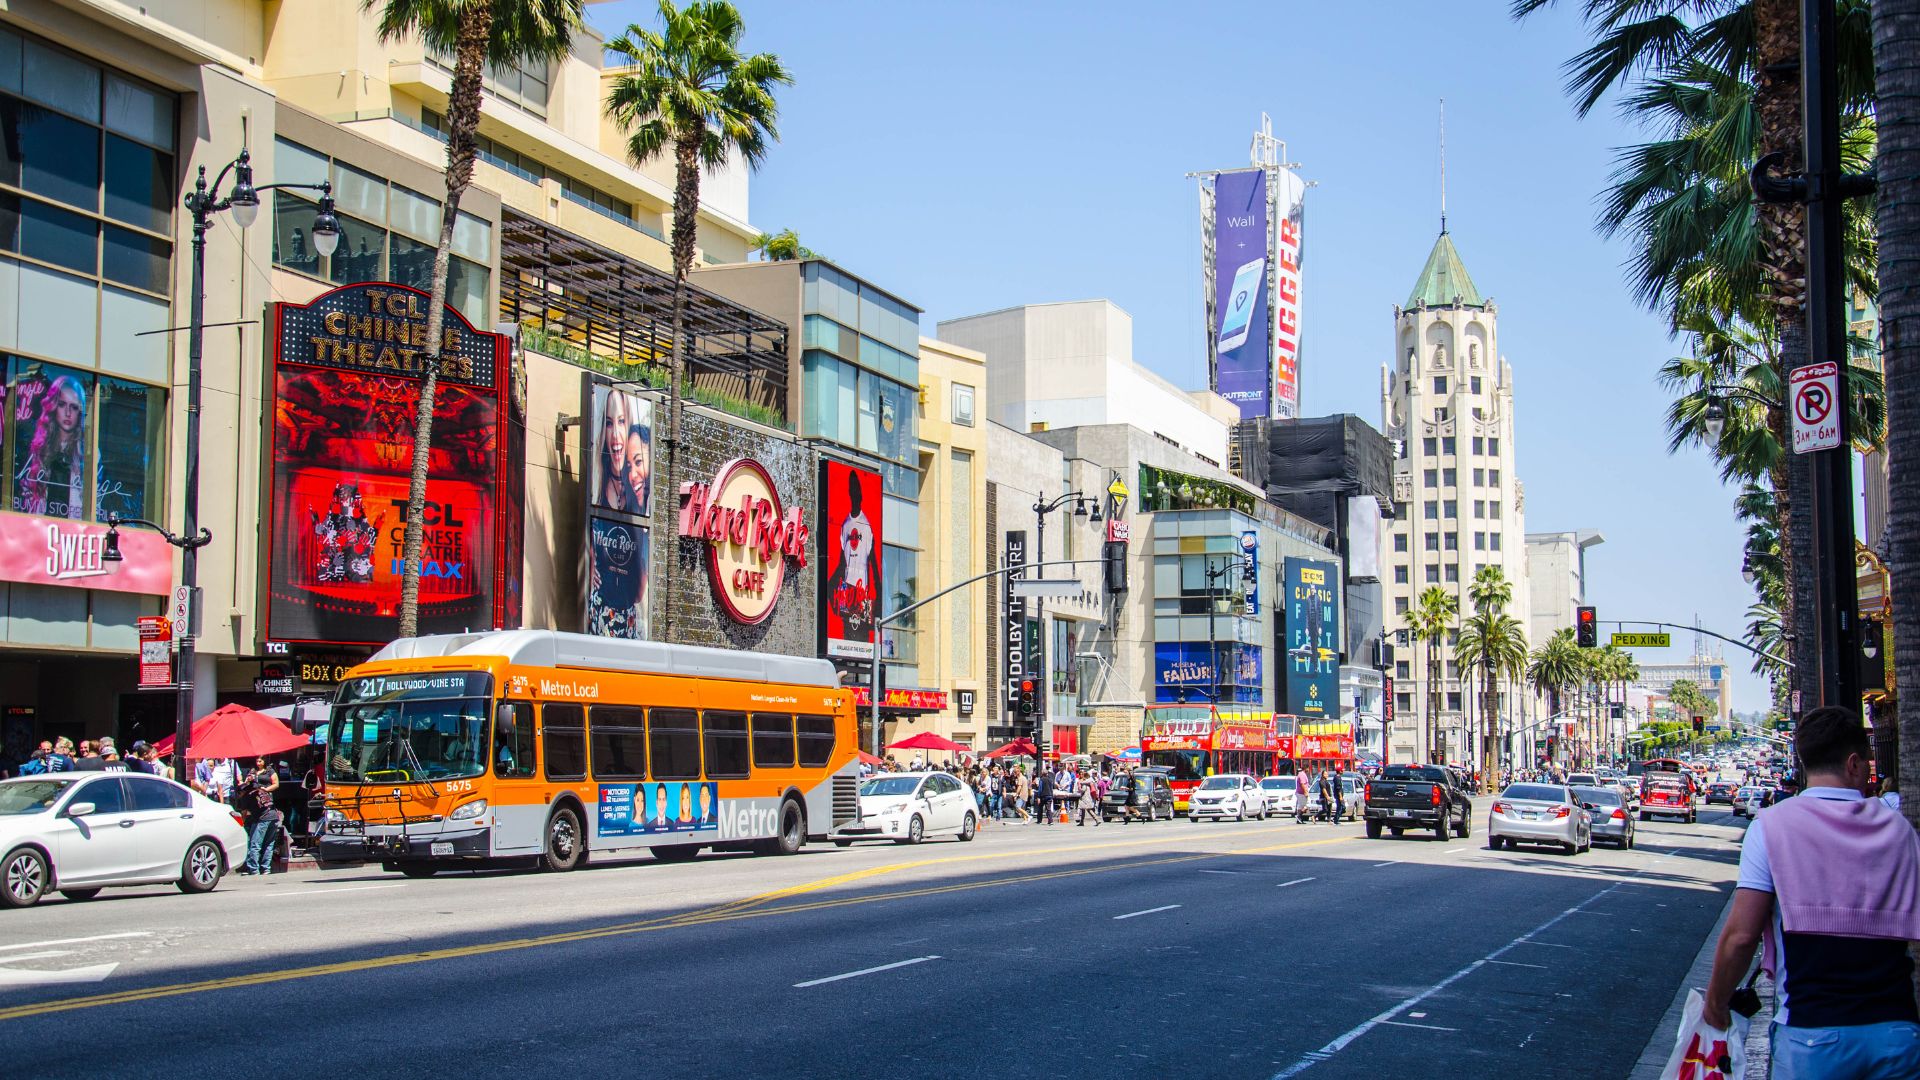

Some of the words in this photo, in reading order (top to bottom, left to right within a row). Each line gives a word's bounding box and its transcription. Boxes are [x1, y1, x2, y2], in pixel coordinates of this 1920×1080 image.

[1227, 215, 1255, 228] Wall
[366, 289, 425, 319] TCL
[1278, 217, 1299, 382] BIGGER
[324, 311, 462, 351] CHINEE
[310, 337, 473, 380] THEATES
[1222, 390, 1263, 399] OUTFRONT
[391, 498, 464, 528] TCL
[679, 481, 752, 546] Hard
[748, 496, 809, 569] Rock
[390, 527, 463, 547] CNESE
[732, 568, 765, 593] CAFE
[1295, 586, 1332, 603] CLASIC
[1295, 603, 1332, 622] FM
[267, 643, 289, 654] TCL
[1009, 620, 1022, 675] DOLBY
[1615, 635, 1636, 645] PED
[1640, 635, 1665, 645] XING
[302, 664, 330, 681] BOX
[512, 675, 528, 686] 5675
[263, 679, 292, 687] CHINESE
[263, 686, 293, 694] THEATRES
[360, 677, 386, 698] 217
[387, 678, 449, 692] HOLLYWOOD/VINE
[450, 676, 464, 688] STA
[541, 679, 571, 697] Metro
[573, 681, 599, 698] Local
[446, 780, 472, 792] 5675
[718, 799, 779, 839] Metro
